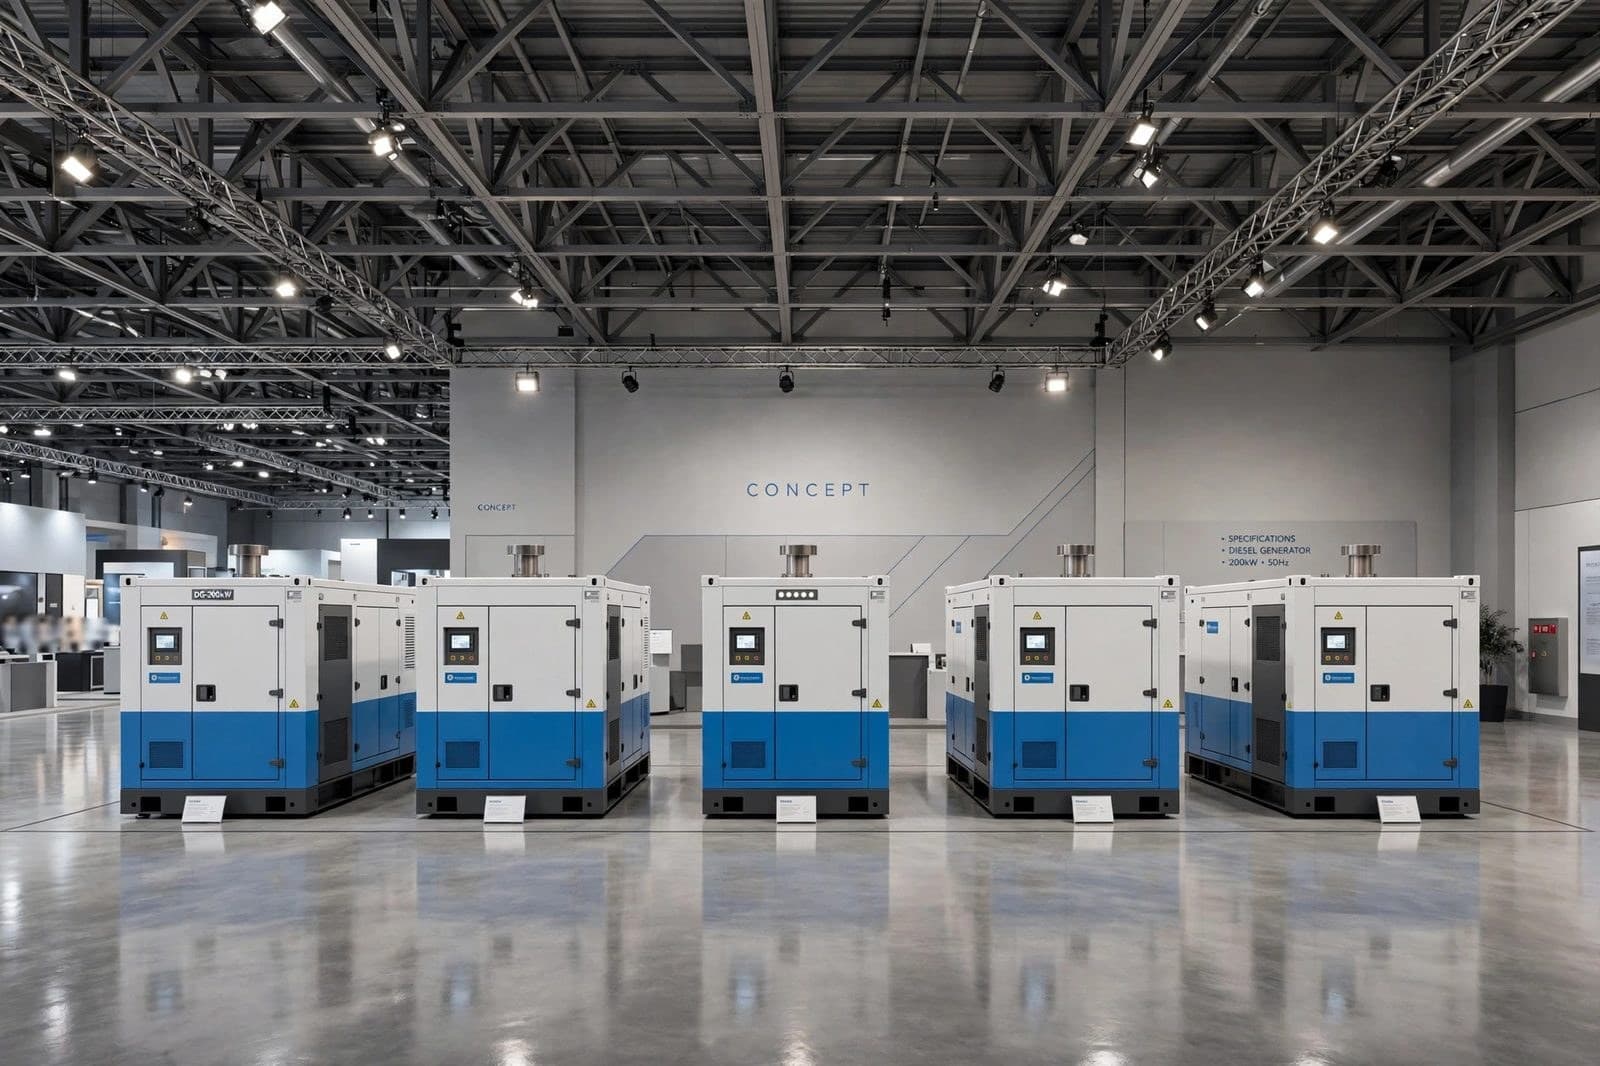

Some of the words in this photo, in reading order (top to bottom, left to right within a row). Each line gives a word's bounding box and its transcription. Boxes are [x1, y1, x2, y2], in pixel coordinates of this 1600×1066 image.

[746, 482, 870, 497] CONCEPT
[477, 503, 516, 511] CONCEPT
[1228, 534, 1296, 543] SPECIFICATIONS
[1228, 546, 1258, 555] DIESEL
[1260, 546, 1311, 555] GENERATOR
[1229, 558, 1258, 566] 200kW
[1268, 558, 1289, 567] 50Hz
